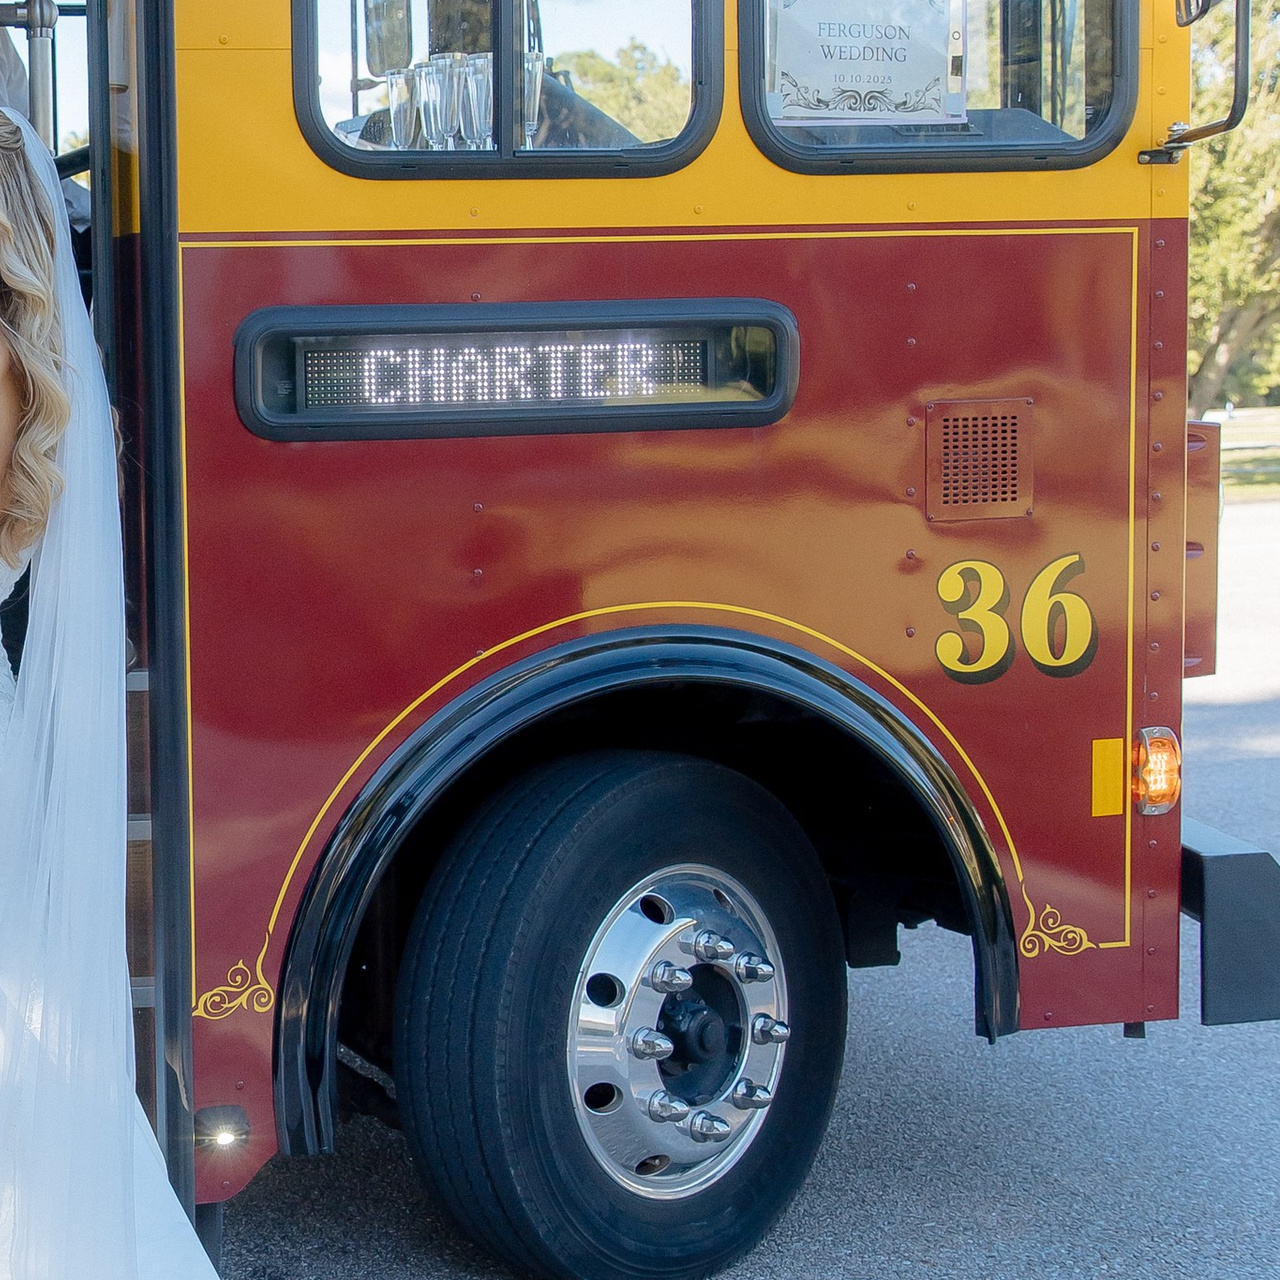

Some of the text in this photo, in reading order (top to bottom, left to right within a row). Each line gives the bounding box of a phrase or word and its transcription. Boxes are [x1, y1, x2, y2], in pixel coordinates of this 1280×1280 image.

[818, 23, 910, 40] FERGUSON
[821, 45, 907, 62] WEDDING
[834, 74, 893, 84] 10.10.2025
[363, 343, 654, 404] CHARTER
[934, 553, 1096, 677] 36
